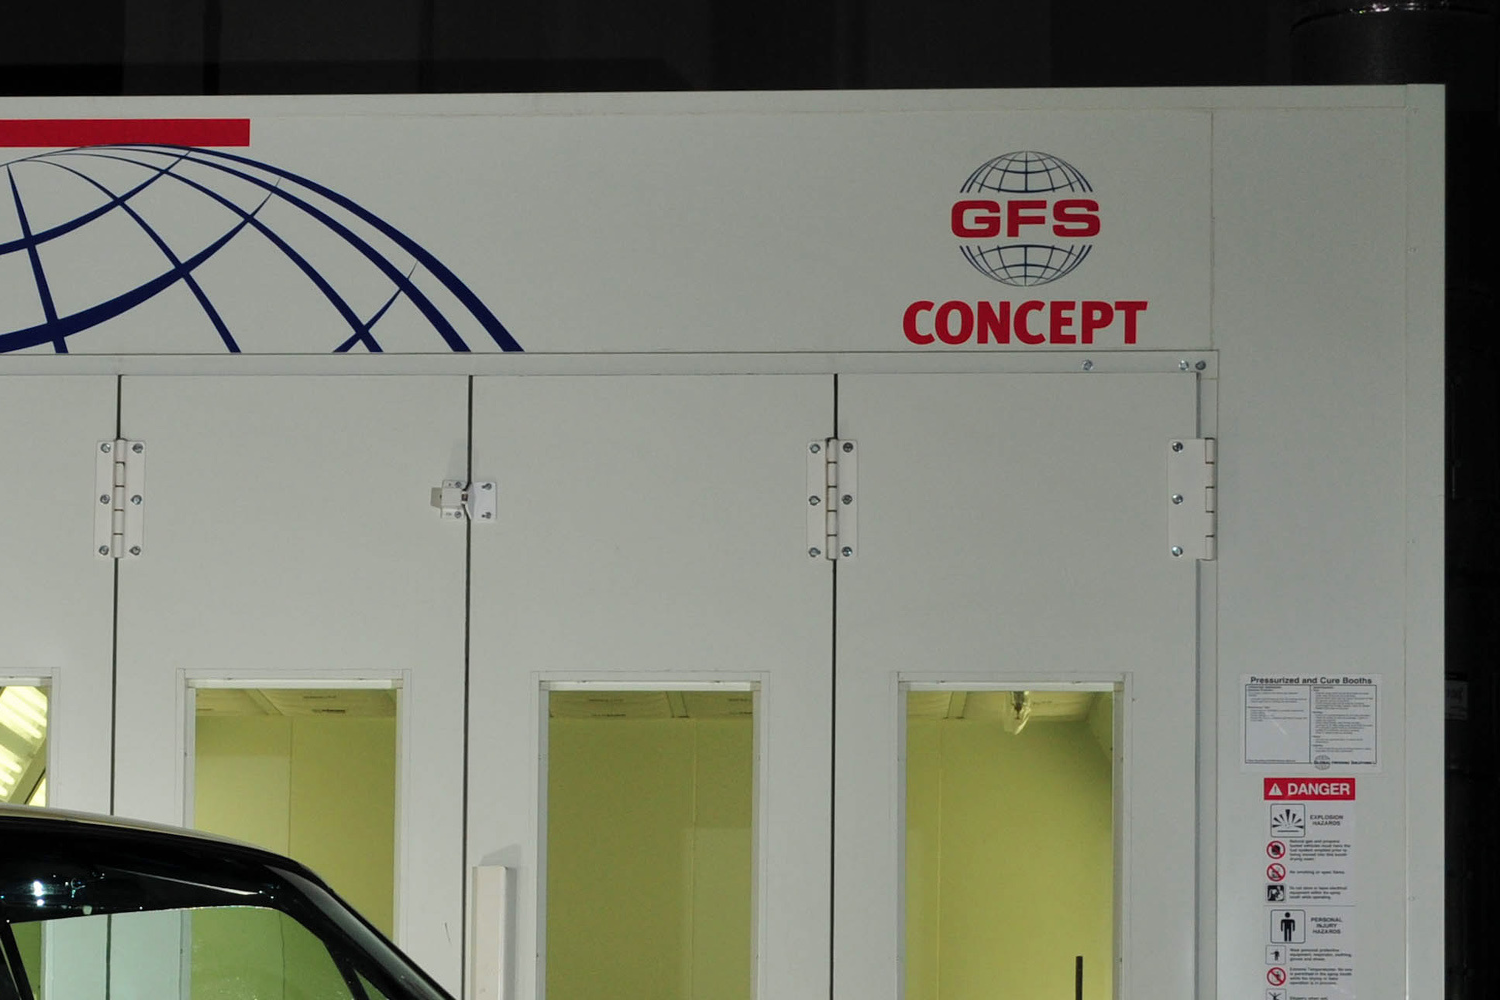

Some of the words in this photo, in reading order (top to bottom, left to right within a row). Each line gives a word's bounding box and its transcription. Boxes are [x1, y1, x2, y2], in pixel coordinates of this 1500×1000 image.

[951, 199, 1101, 239] GFS
[903, 300, 1148, 345] CONCEPT
[1250, 676, 1300, 684] Pressurized
[1301, 676, 1318, 684] and
[1319, 676, 1340, 684] Cure
[1342, 677, 1373, 685] Booths
[1287, 783, 1351, 795] DANGER
